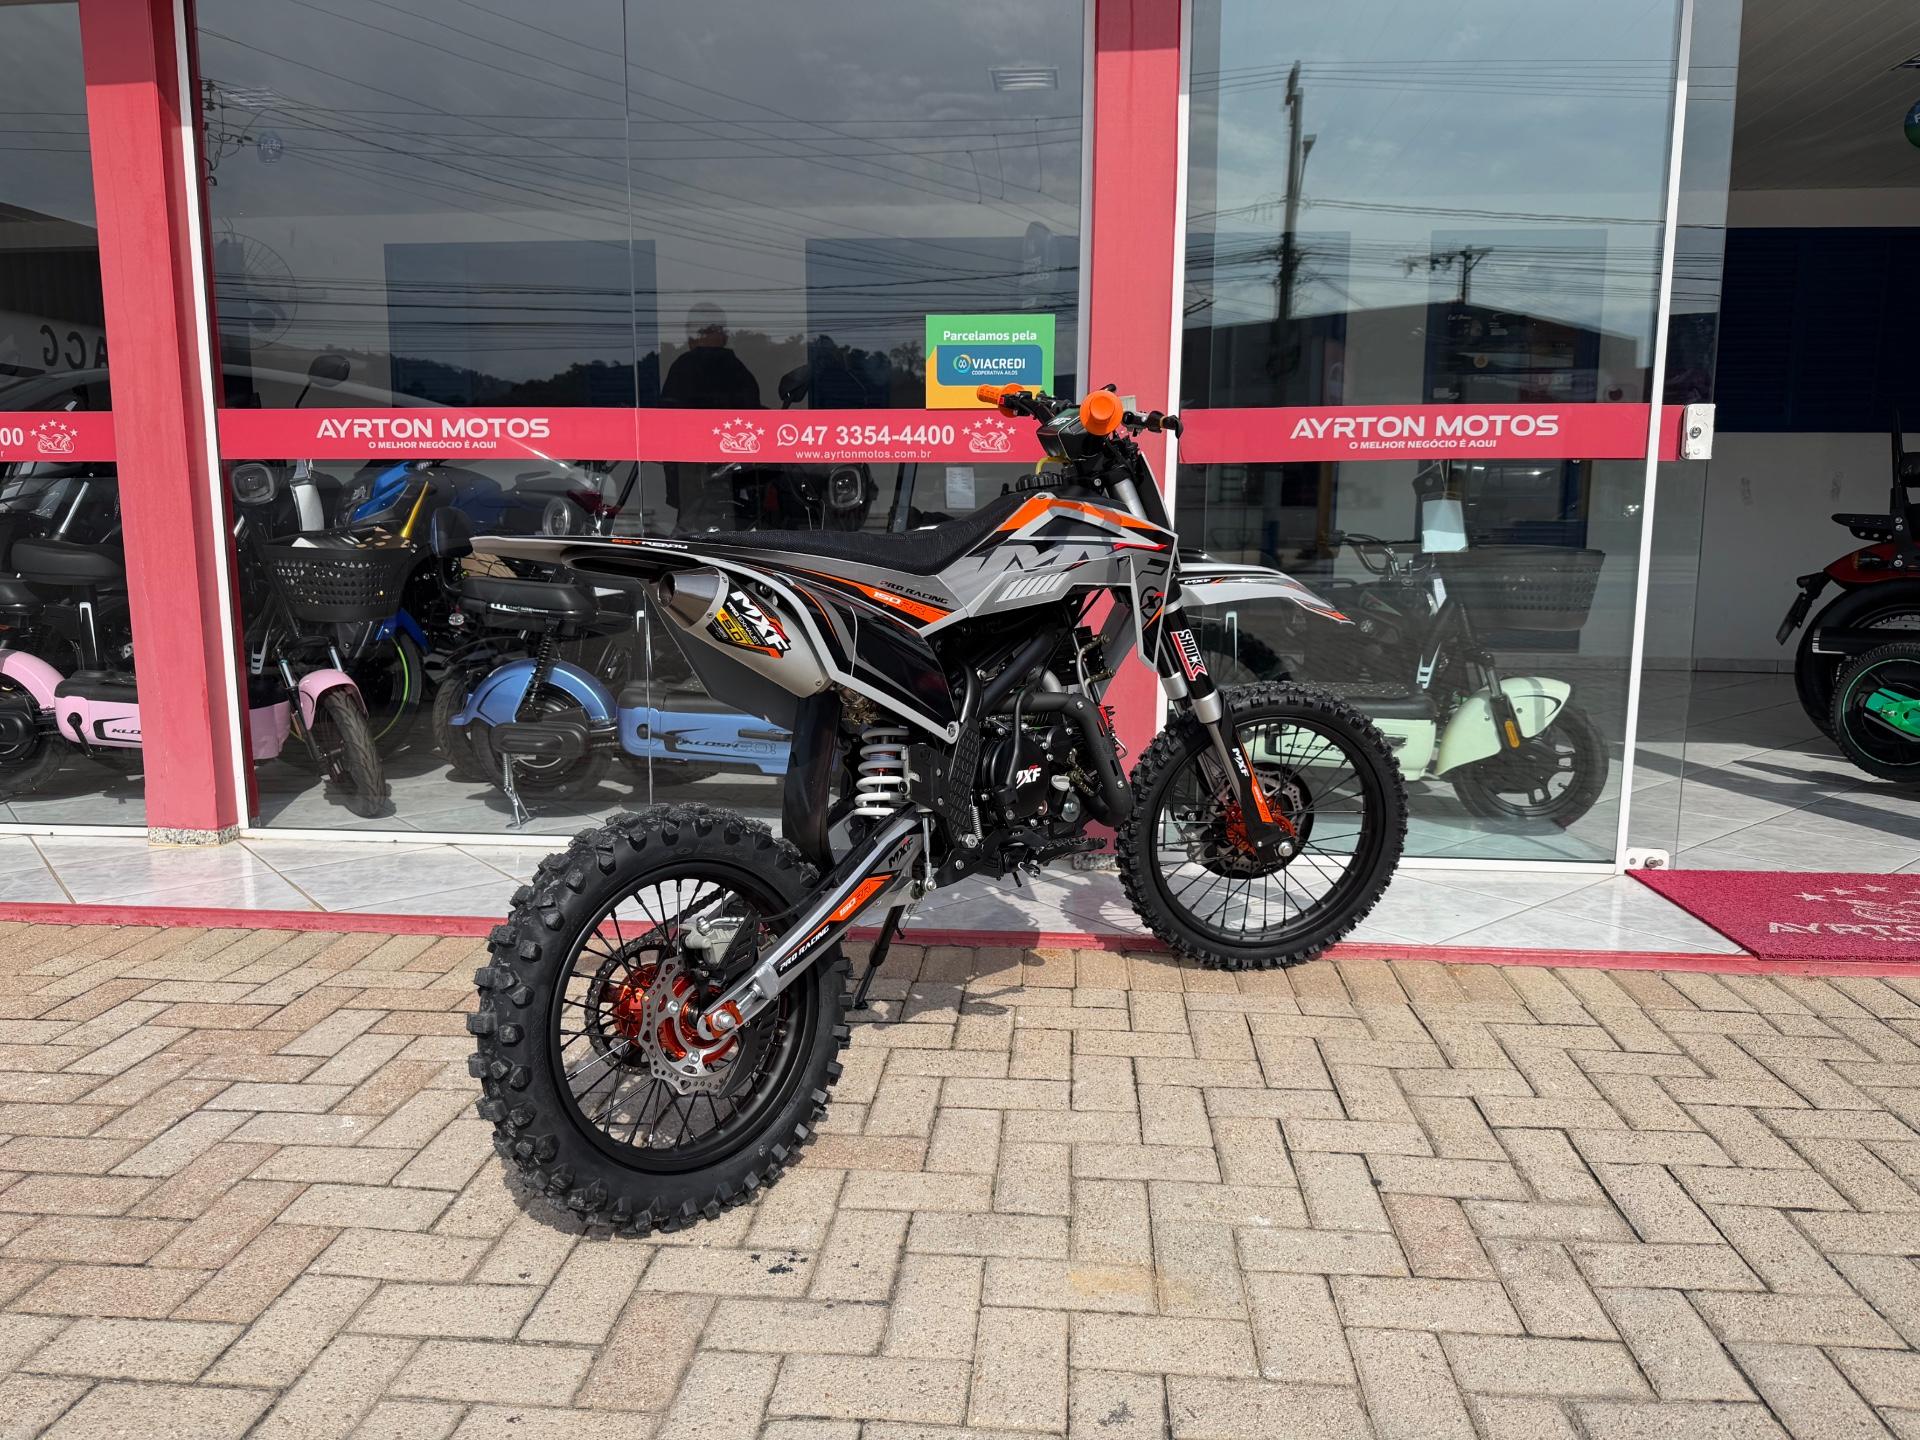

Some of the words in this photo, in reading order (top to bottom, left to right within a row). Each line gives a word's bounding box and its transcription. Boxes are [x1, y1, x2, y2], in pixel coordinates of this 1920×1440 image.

[943, 330, 1010, 341] Parcelamos
[1012, 330, 1037, 343] pela
[972, 358, 1026, 369] VIACREDI
[316, 418, 433, 439] AYRTON
[442, 417, 551, 439] MOTOS
[800, 425, 828, 446] 47
[835, 425, 955, 446] 3354-4400
[1290, 416, 1425, 439] AYRTON
[1435, 415, 1559, 437] MOTOS
[378, 441, 417, 449] MELHOR
[419, 440, 462, 449] NEGÓCIO
[464, 440, 470, 448] É
[472, 441, 497, 449] AQUI
[795, 450, 932, 461] www.ayrtonmotos.com.br
[1349, 442, 1358, 450] O
[1360, 441, 1405, 449] MELHOR
[1407, 439, 1457, 449] NEGÓCIO
[1459, 439, 1466, 448] É
[1468, 440, 1497, 448] AQUI
[880, 580, 905, 592] PRO
[906, 588, 950, 605] RACING
[730, 590, 790, 650] MXF
[1179, 628, 1204, 669] SHOCK
[1231, 747, 1250, 777] MXF
[779, 953, 798, 972] PRO
[798, 924, 830, 956] RACING
